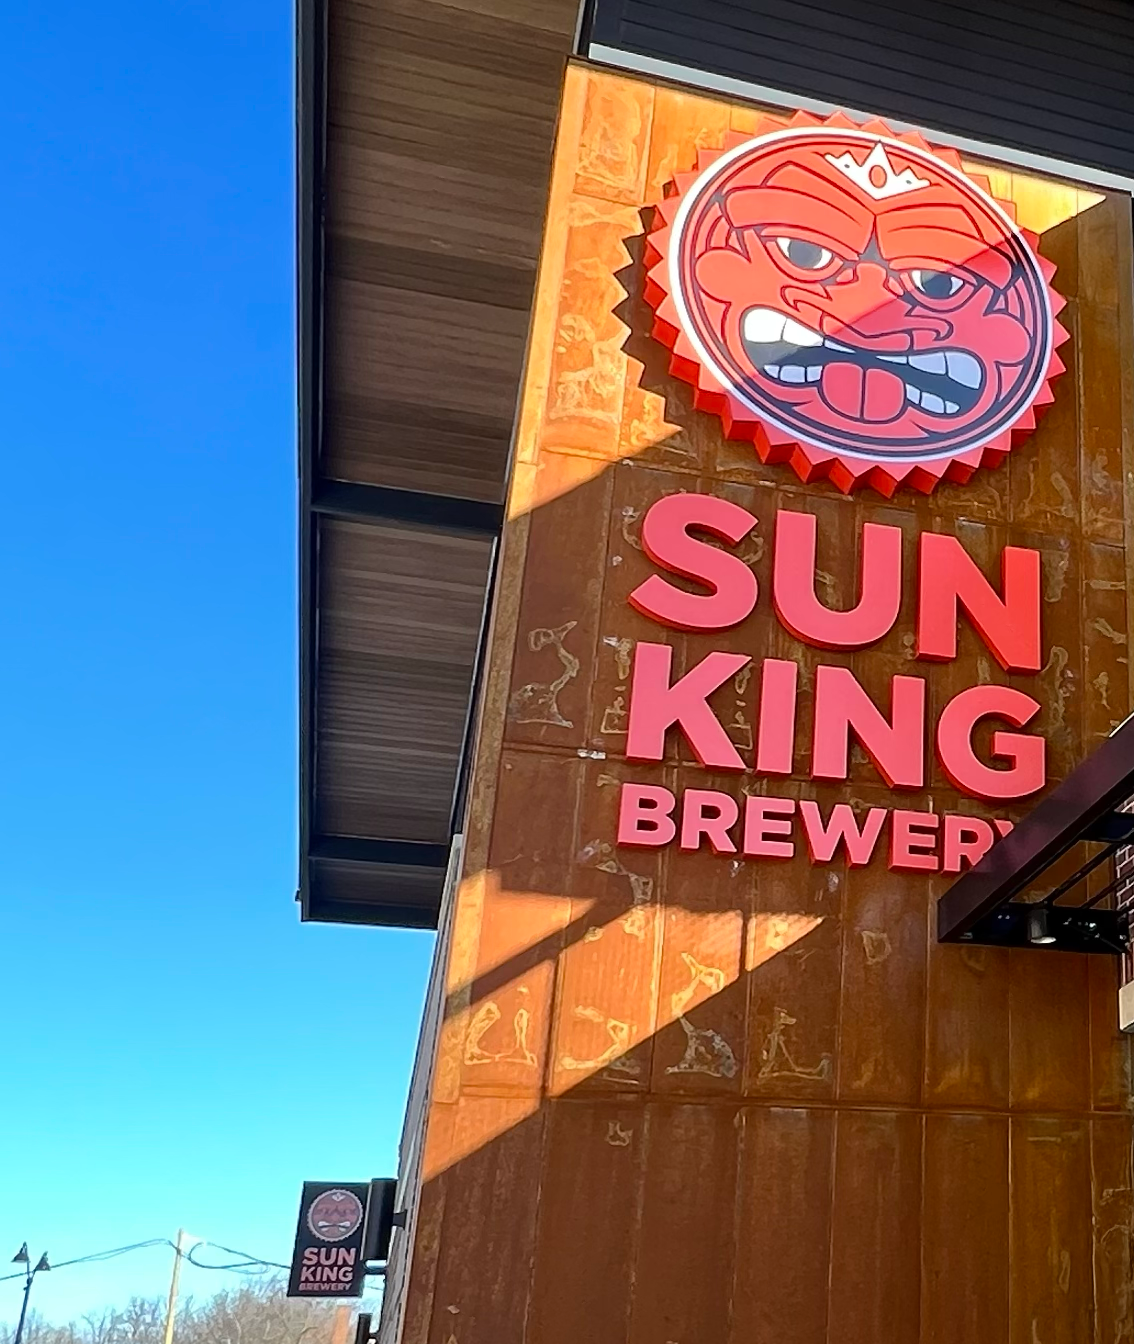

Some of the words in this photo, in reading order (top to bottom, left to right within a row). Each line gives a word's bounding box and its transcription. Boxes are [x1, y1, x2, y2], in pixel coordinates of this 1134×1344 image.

[627, 492, 1042, 674] SUN
[625, 641, 1046, 800] KING
[616, 782, 1014, 875] BREWER
[300, 1266, 353, 1282] KING
[302, 1247, 356, 1265] SUN
[299, 1282, 352, 1291] BREWERY
